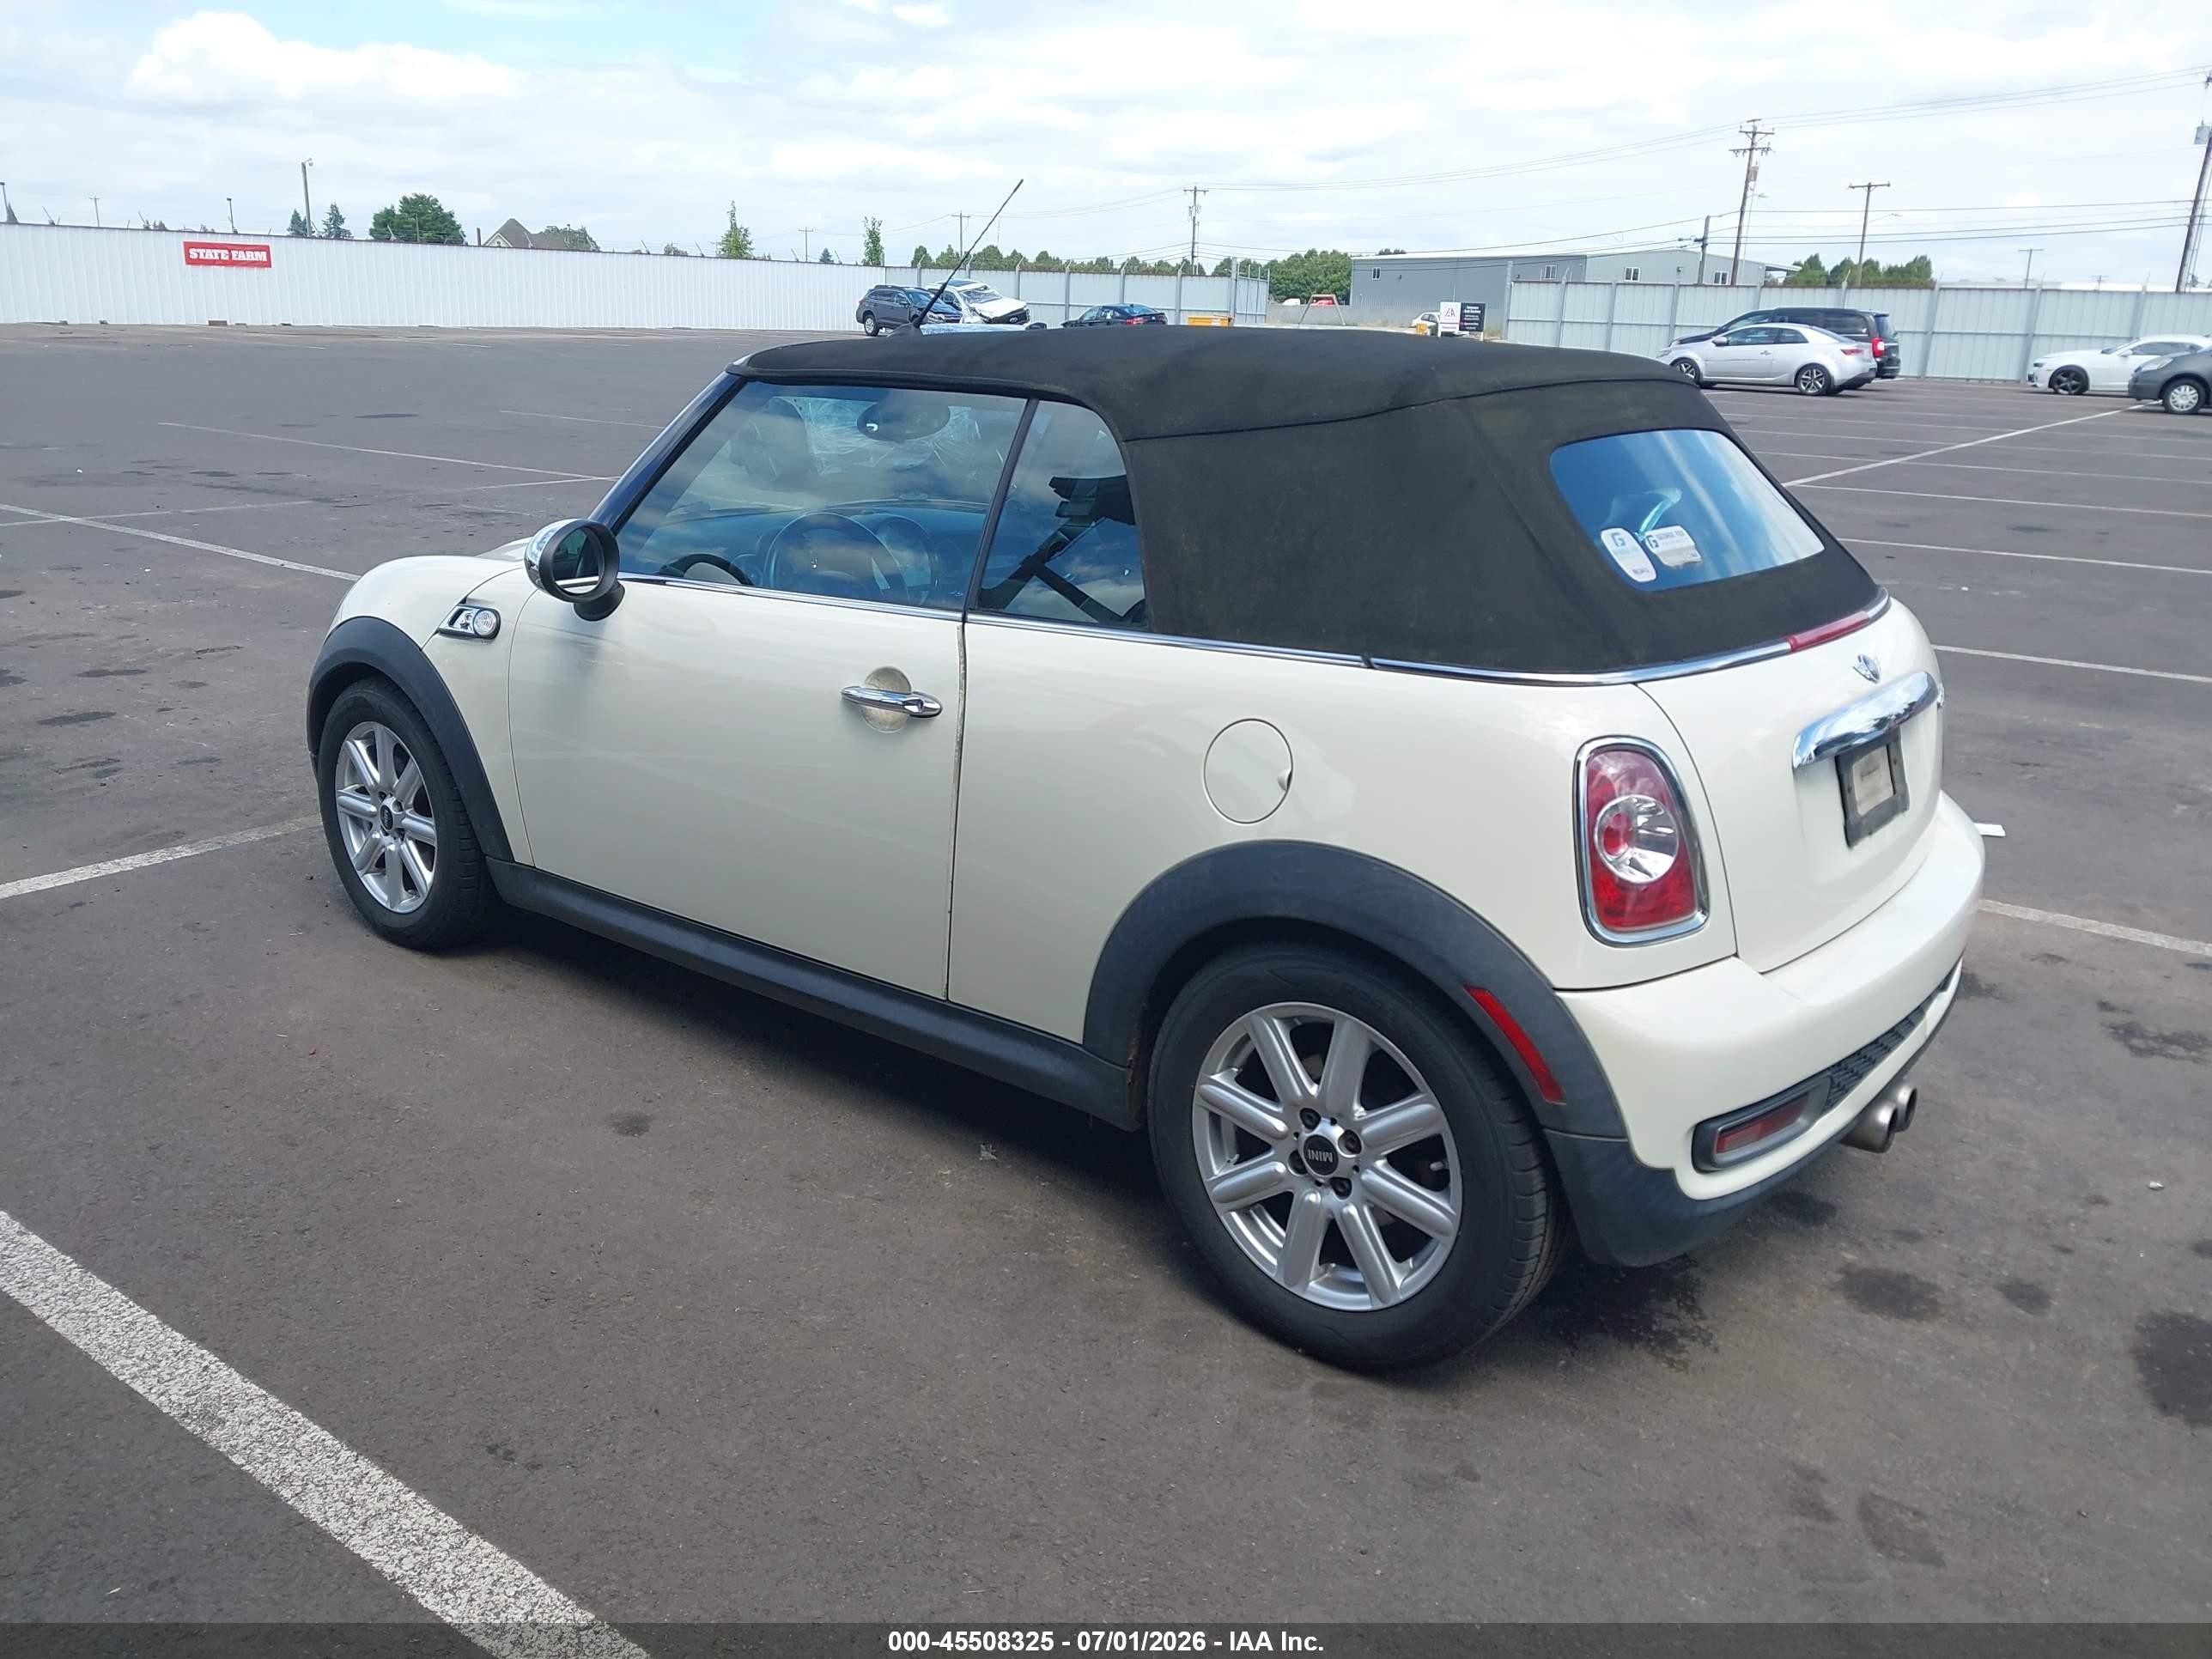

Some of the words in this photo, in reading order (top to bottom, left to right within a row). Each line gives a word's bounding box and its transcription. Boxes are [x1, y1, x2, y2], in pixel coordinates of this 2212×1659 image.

[189, 247, 229, 260] STATE
[230, 250, 268, 262] FARM
[1308, 1149, 1334, 1164] MINI
